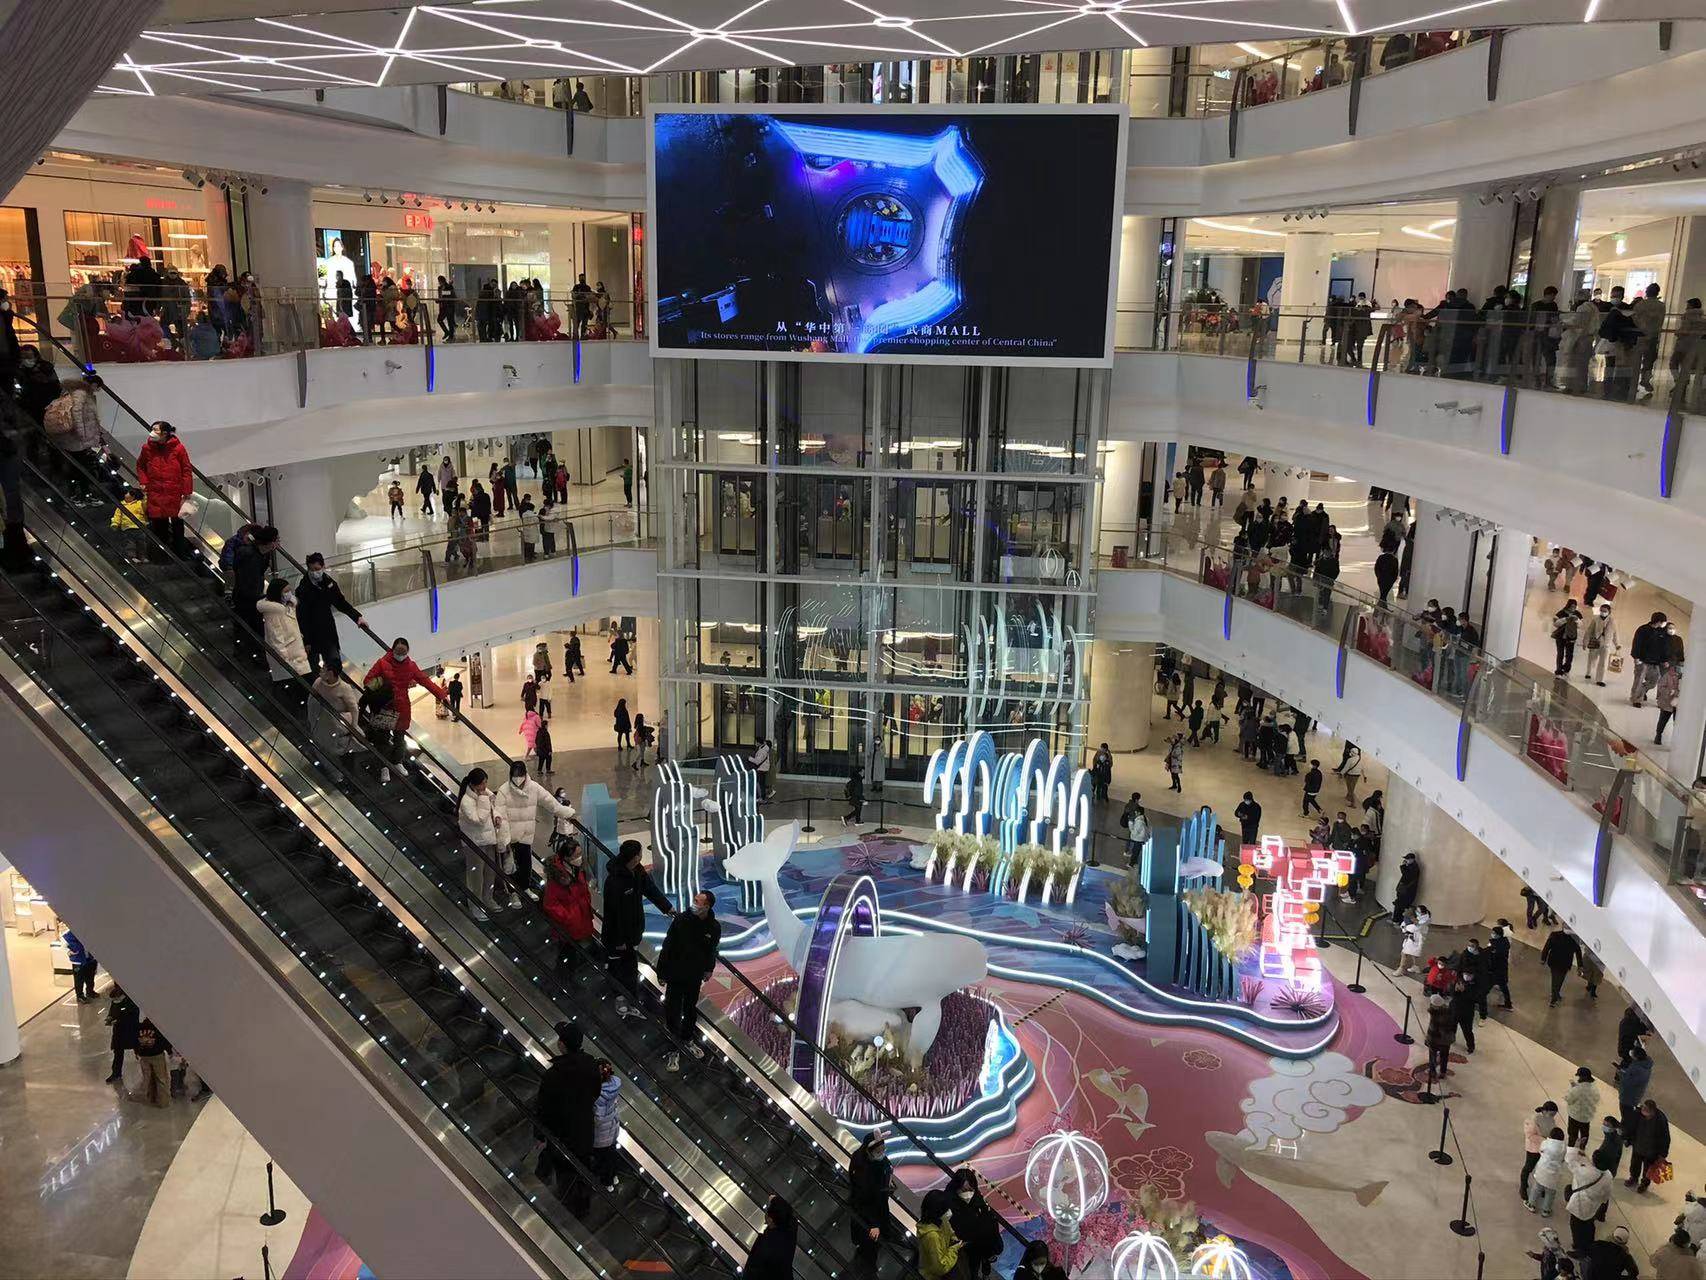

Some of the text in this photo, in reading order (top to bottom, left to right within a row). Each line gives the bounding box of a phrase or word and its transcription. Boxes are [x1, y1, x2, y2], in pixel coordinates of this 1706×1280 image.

[776, 321, 788, 333] 从
[700, 331, 712, 340] Its
[714, 332, 739, 341] stores
[740, 333, 764, 343] range
[766, 332, 787, 342] from
[909, 336, 950, 347] shopping
[951, 338, 980, 347] center
[981, 337, 992, 347] of
[992, 338, 1026, 348] Central
